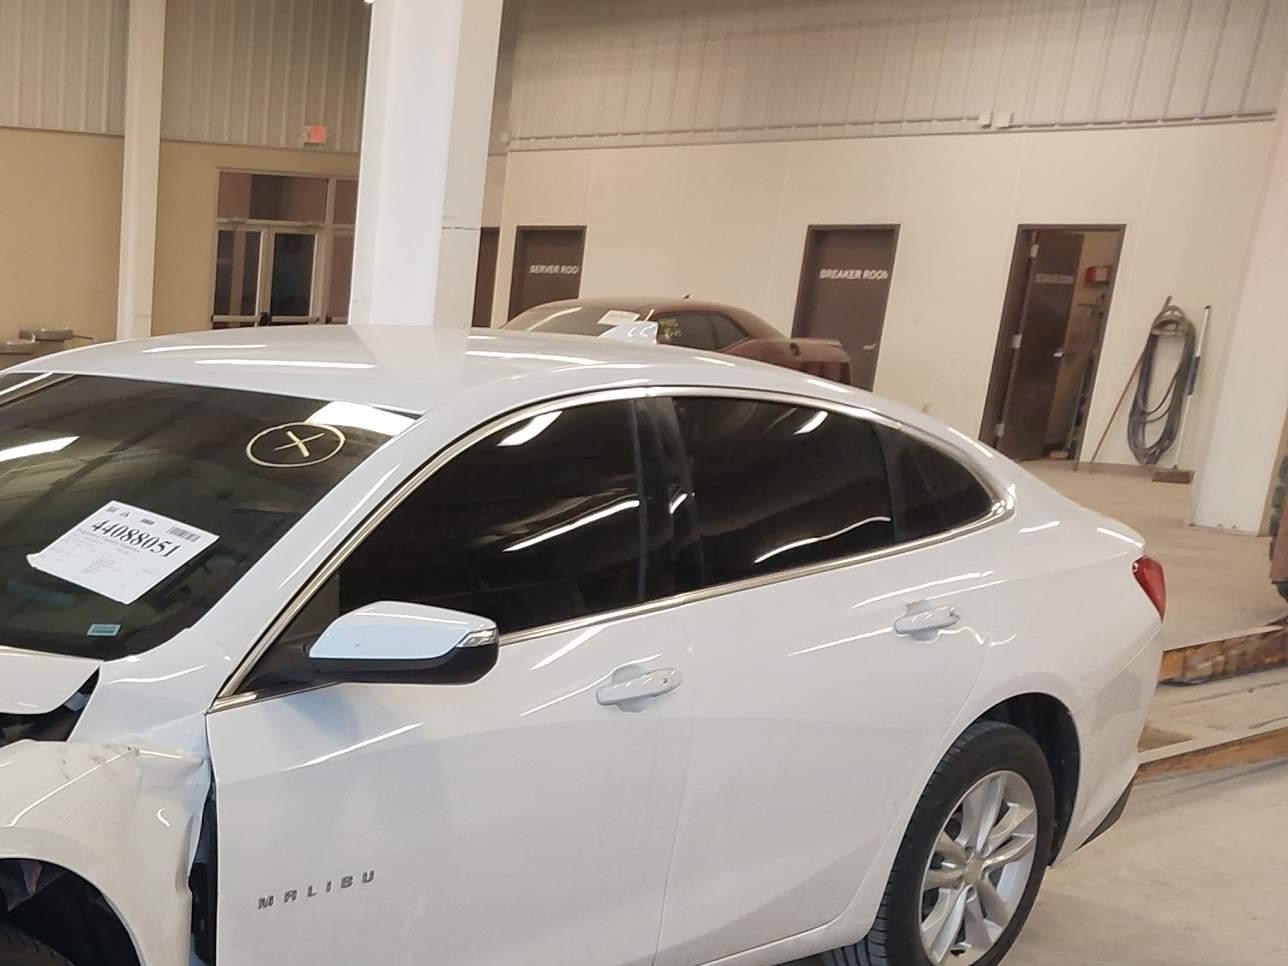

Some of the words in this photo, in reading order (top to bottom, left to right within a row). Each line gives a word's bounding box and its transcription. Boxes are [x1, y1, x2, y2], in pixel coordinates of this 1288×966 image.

[529, 264, 560, 274] SERVER
[819, 268, 863, 279] BREAKER
[91, 519, 181, 557] 44088051
[258, 870, 375, 909] MALIBU
